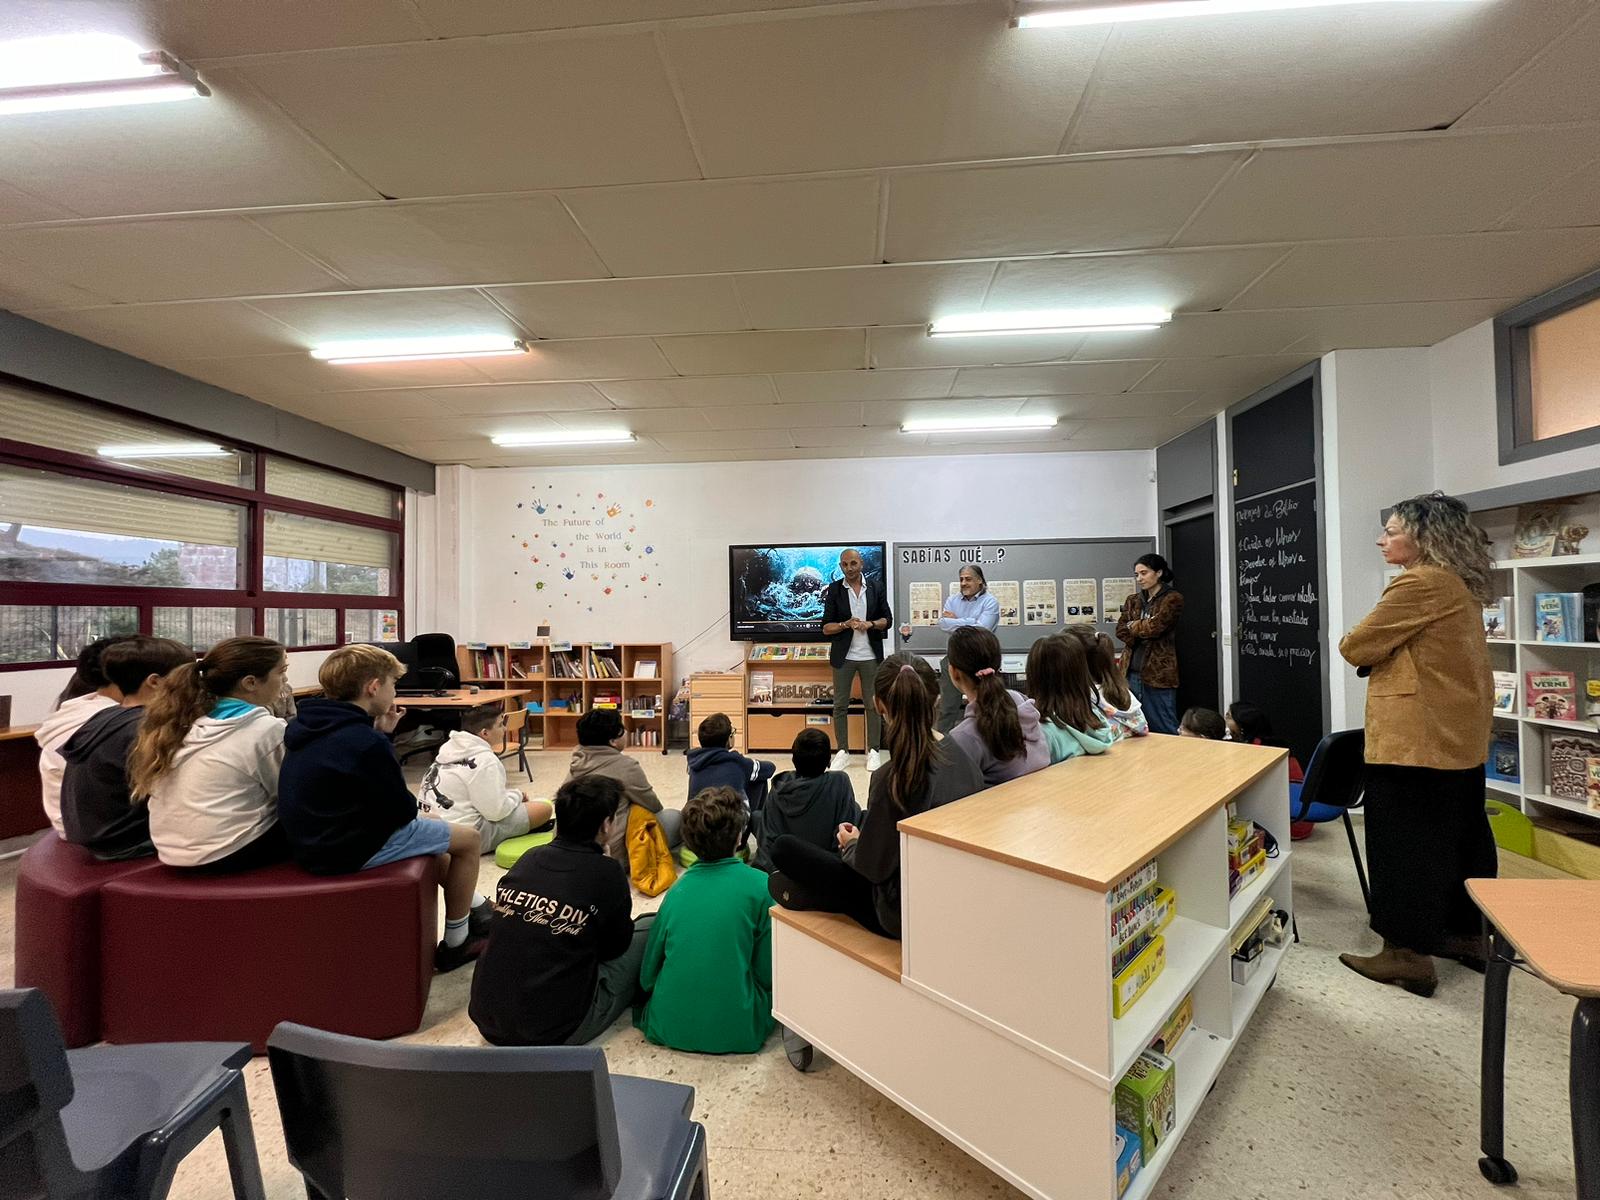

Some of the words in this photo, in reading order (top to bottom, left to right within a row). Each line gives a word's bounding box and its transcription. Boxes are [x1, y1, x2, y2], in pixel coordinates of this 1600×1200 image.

[542, 518, 558, 527] The
[563, 518, 591, 527] Future
[595, 518, 605, 526] of
[575, 532, 590, 541] the
[595, 532, 622, 541] World
[586, 545, 594, 553] is
[598, 545, 607, 553] in
[902, 547, 951, 563] SABÍAS
[580, 560, 598, 569] This
[604, 560, 630, 569] Room
[773, 684, 835, 699] BIBLIOTEC
[497, 887, 558, 914] THLETICS
[560, 904, 589, 926] DIV.
